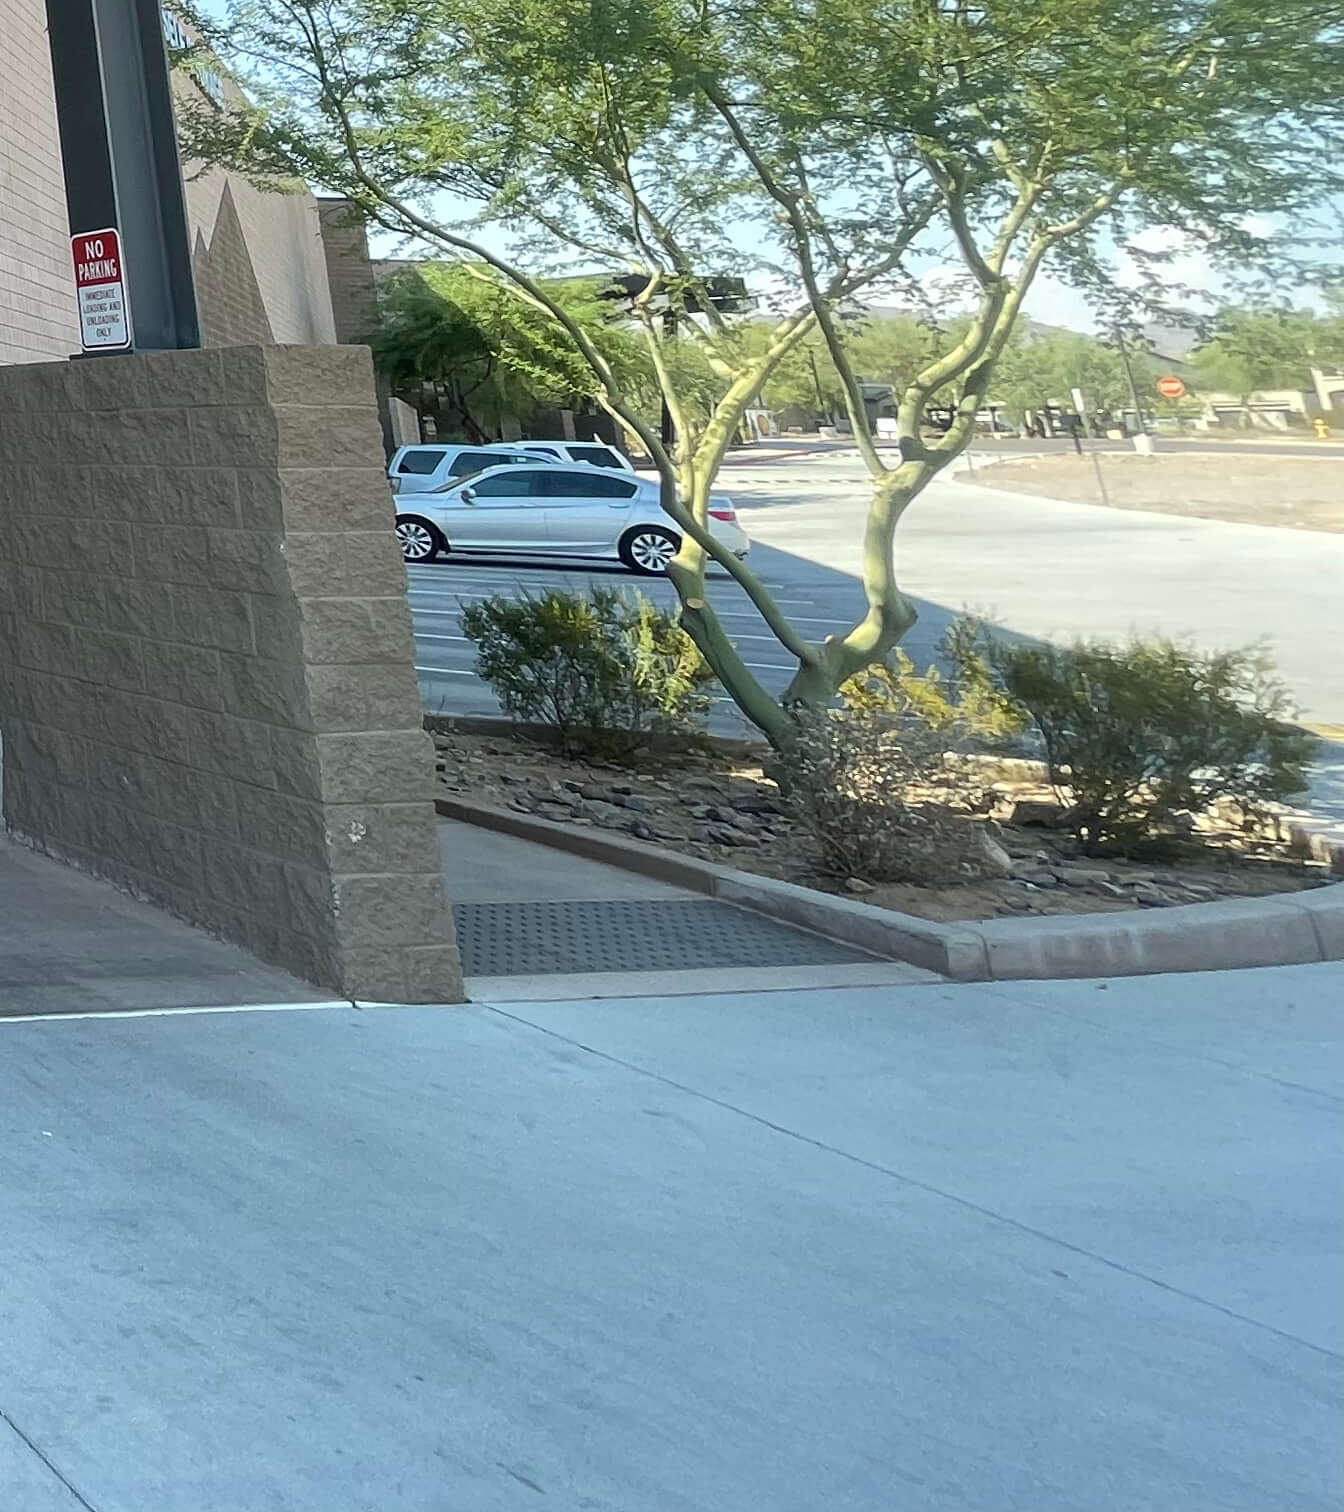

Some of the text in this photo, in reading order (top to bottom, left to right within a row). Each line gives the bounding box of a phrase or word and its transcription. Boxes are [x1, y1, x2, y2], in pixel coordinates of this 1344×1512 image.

[85, 240, 104, 259] NO
[78, 259, 117, 281] PARKING
[96, 328, 112, 337] ONLY
